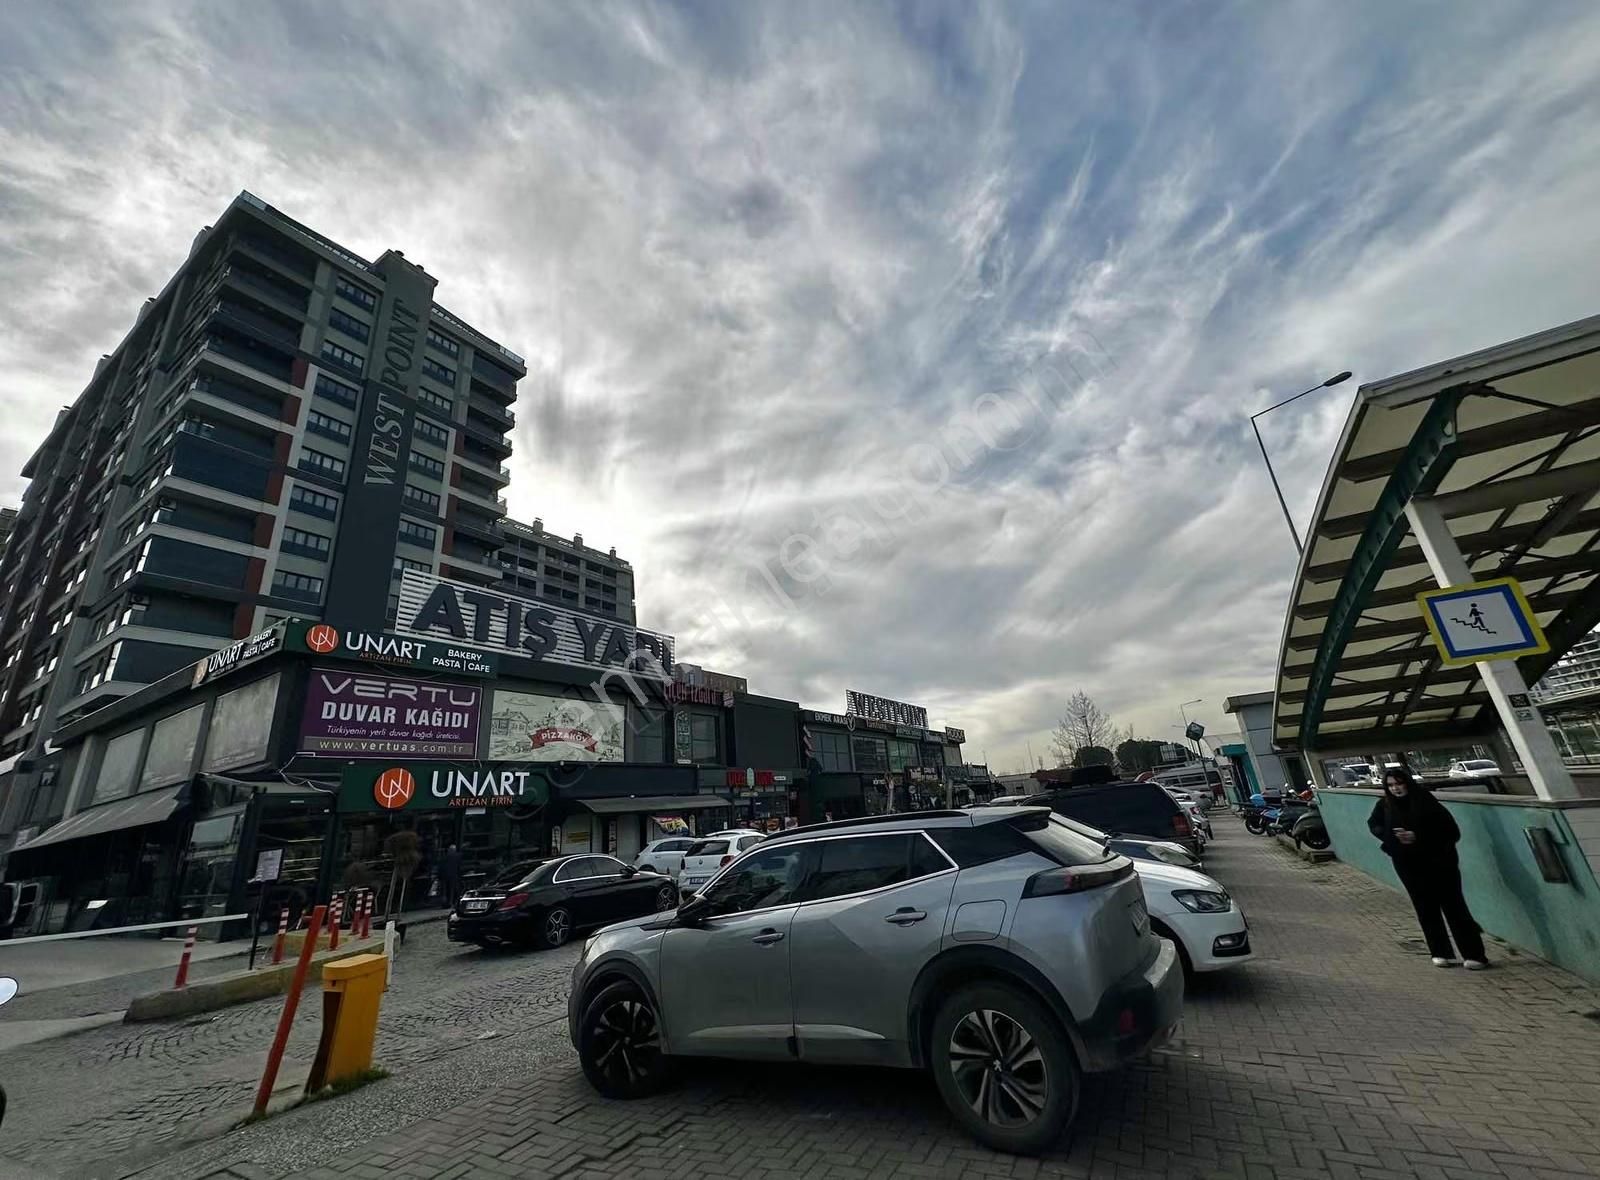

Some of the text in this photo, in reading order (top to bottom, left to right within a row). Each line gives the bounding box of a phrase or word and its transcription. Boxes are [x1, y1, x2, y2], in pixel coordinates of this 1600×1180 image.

[363, 297, 420, 485] WEST POINT
[411, 584, 558, 660] ATIŞ
[208, 642, 244, 673] UNART
[345, 631, 427, 660] UNART
[448, 649, 483, 662] BAKERY
[432, 657, 491, 673] PASTA CAFE
[321, 674, 476, 706] VERTU
[321, 701, 470, 728] DUVAR KAĞIDI
[319, 740, 464, 752] www.vertuas.com.tr
[431, 770, 530, 798] UNART
